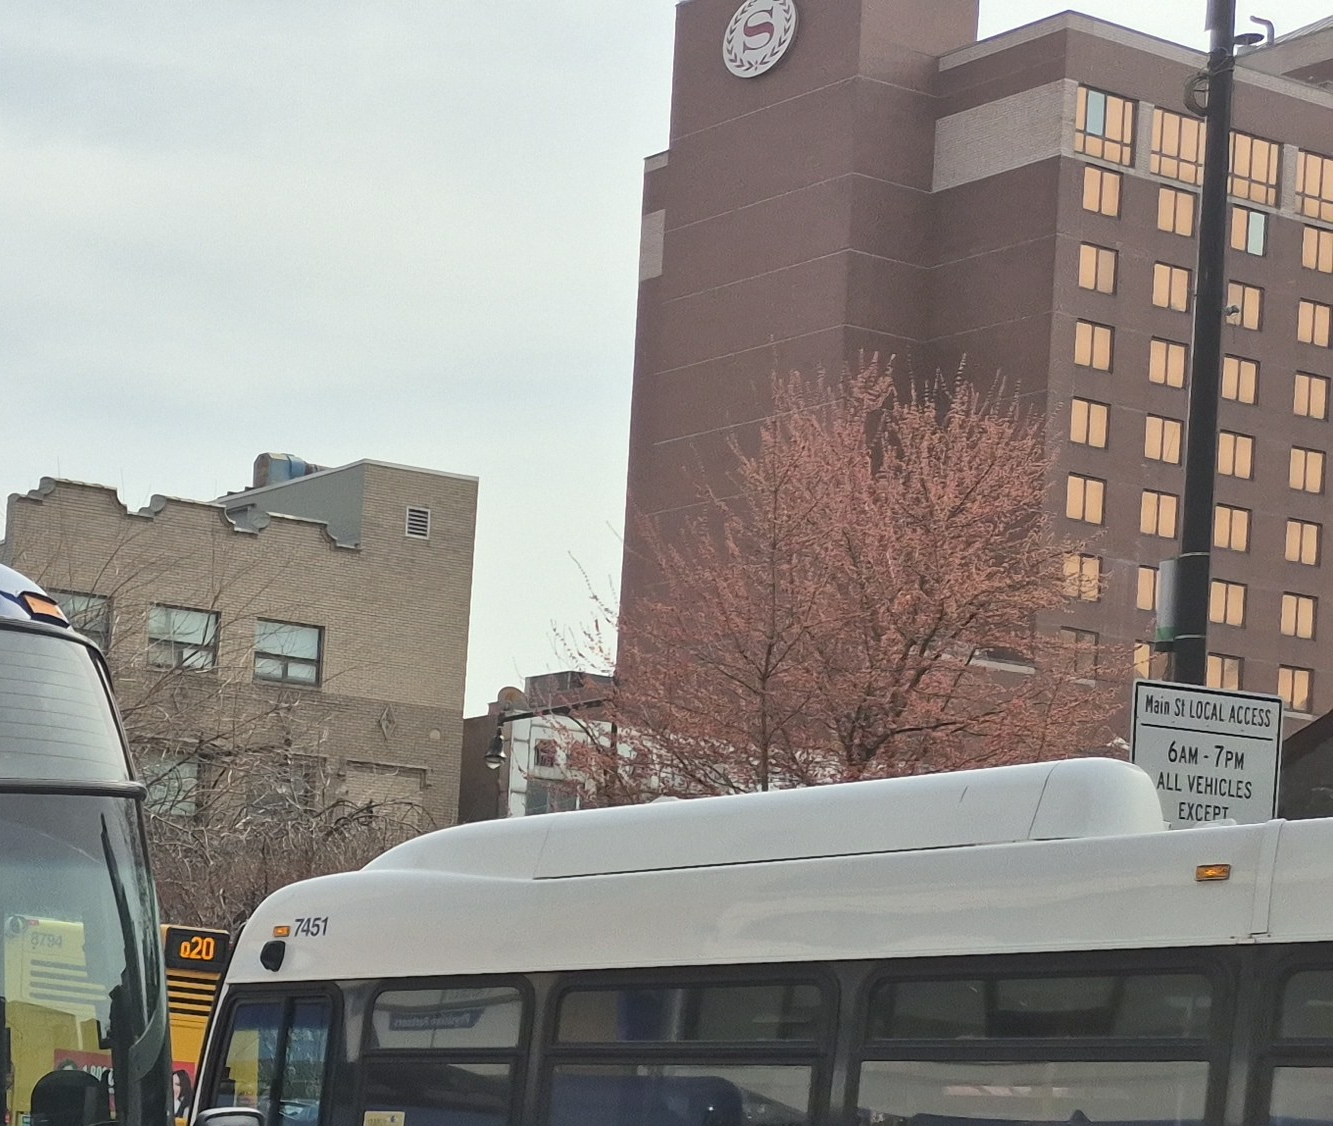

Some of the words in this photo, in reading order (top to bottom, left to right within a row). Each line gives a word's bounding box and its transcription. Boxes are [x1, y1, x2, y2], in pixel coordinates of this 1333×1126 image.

[743, 6, 774, 54] S
[1145, 695, 1170, 716] Main
[1174, 698, 1186, 718] St
[1190, 702, 1224, 722] LOCAL
[1228, 706, 1272, 728] ACCESS
[1168, 740, 1198, 765] 6AM
[1214, 745, 1244, 770] 7PM
[1156, 772, 1182, 792] ALL
[1188, 775, 1252, 800] VEHICLES
[1178, 802, 1229, 822] EXCEPT
[294, 916, 328, 938] 7451
[180, 936, 215, 960] Q20
